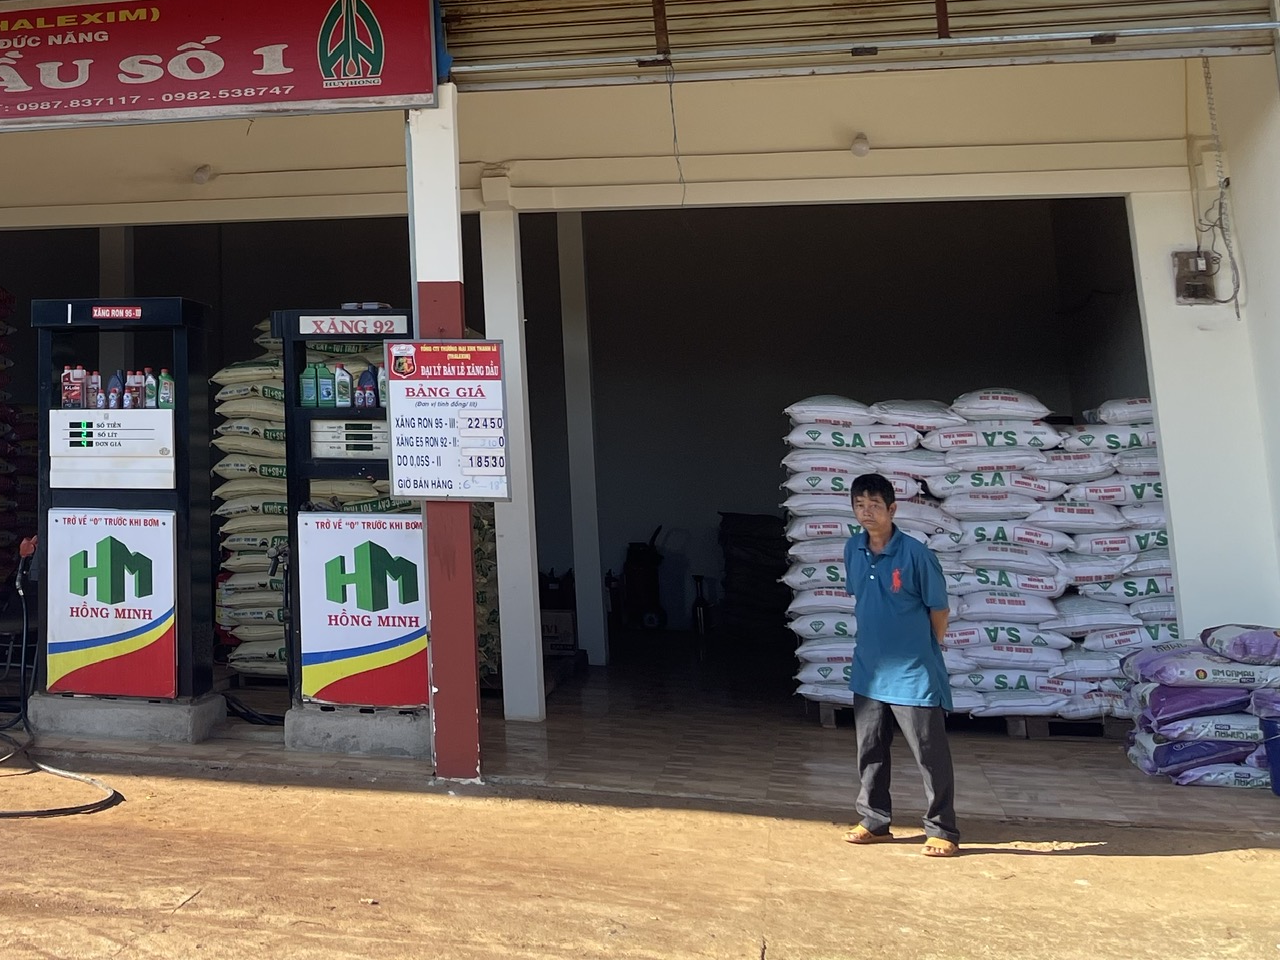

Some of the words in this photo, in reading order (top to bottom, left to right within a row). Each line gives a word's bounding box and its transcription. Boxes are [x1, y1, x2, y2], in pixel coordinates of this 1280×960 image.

[48, 30, 109, 46] NĂNG
[118, 35, 225, 84] SỐ
[252, 44, 294, 75] 1
[16, 95, 141, 112] 0987.837117
[161, 85, 294, 102] 0982.538747
[312, 318, 368, 334] XĂNG
[373, 320, 394, 334] 92
[421, 365, 432, 379] ĐẠI
[466, 363, 484, 376] XĂNG
[406, 383, 450, 397] BẢNG
[456, 385, 486, 397] GIÁ
[395, 415, 416, 428] XĂNG
[417, 418, 433, 428] RON
[435, 418, 443, 428] 95
[467, 418, 503, 429] 22450
[396, 434, 414, 447] XĂNG
[415, 437, 424, 447] E5
[425, 437, 439, 447] RON
[440, 437, 448, 447] 92
[831, 431, 866, 448] S.A
[982, 431, 1018, 447] S.A
[1105, 433, 1142, 449] S.A
[397, 455, 408, 466] DO
[410, 455, 430, 468] 0,05S
[469, 456, 505, 468] 18530
[398, 477, 411, 489] GIỜ
[413, 477, 429, 489] BÁN
[431, 477, 453, 489] HÀNG
[970, 471, 1005, 487] S.A
[63, 514, 77, 525] TRỞ
[129, 518, 142, 526] KHI
[143, 518, 160, 527] BƠM
[315, 519, 331, 530] TRỞ
[389, 521, 403, 530] KHI
[974, 526, 1008, 542] S.A
[1135, 530, 1168, 550] S.A
[975, 567, 1012, 588] S.A
[1123, 578, 1160, 597] S.A
[69, 601, 110, 618] HỒNG
[114, 609, 153, 620] MINH
[328, 609, 372, 627] HỒNG
[377, 615, 420, 627] MINH
[983, 626, 1021, 644] S.A
[994, 674, 1029, 690] S.A
